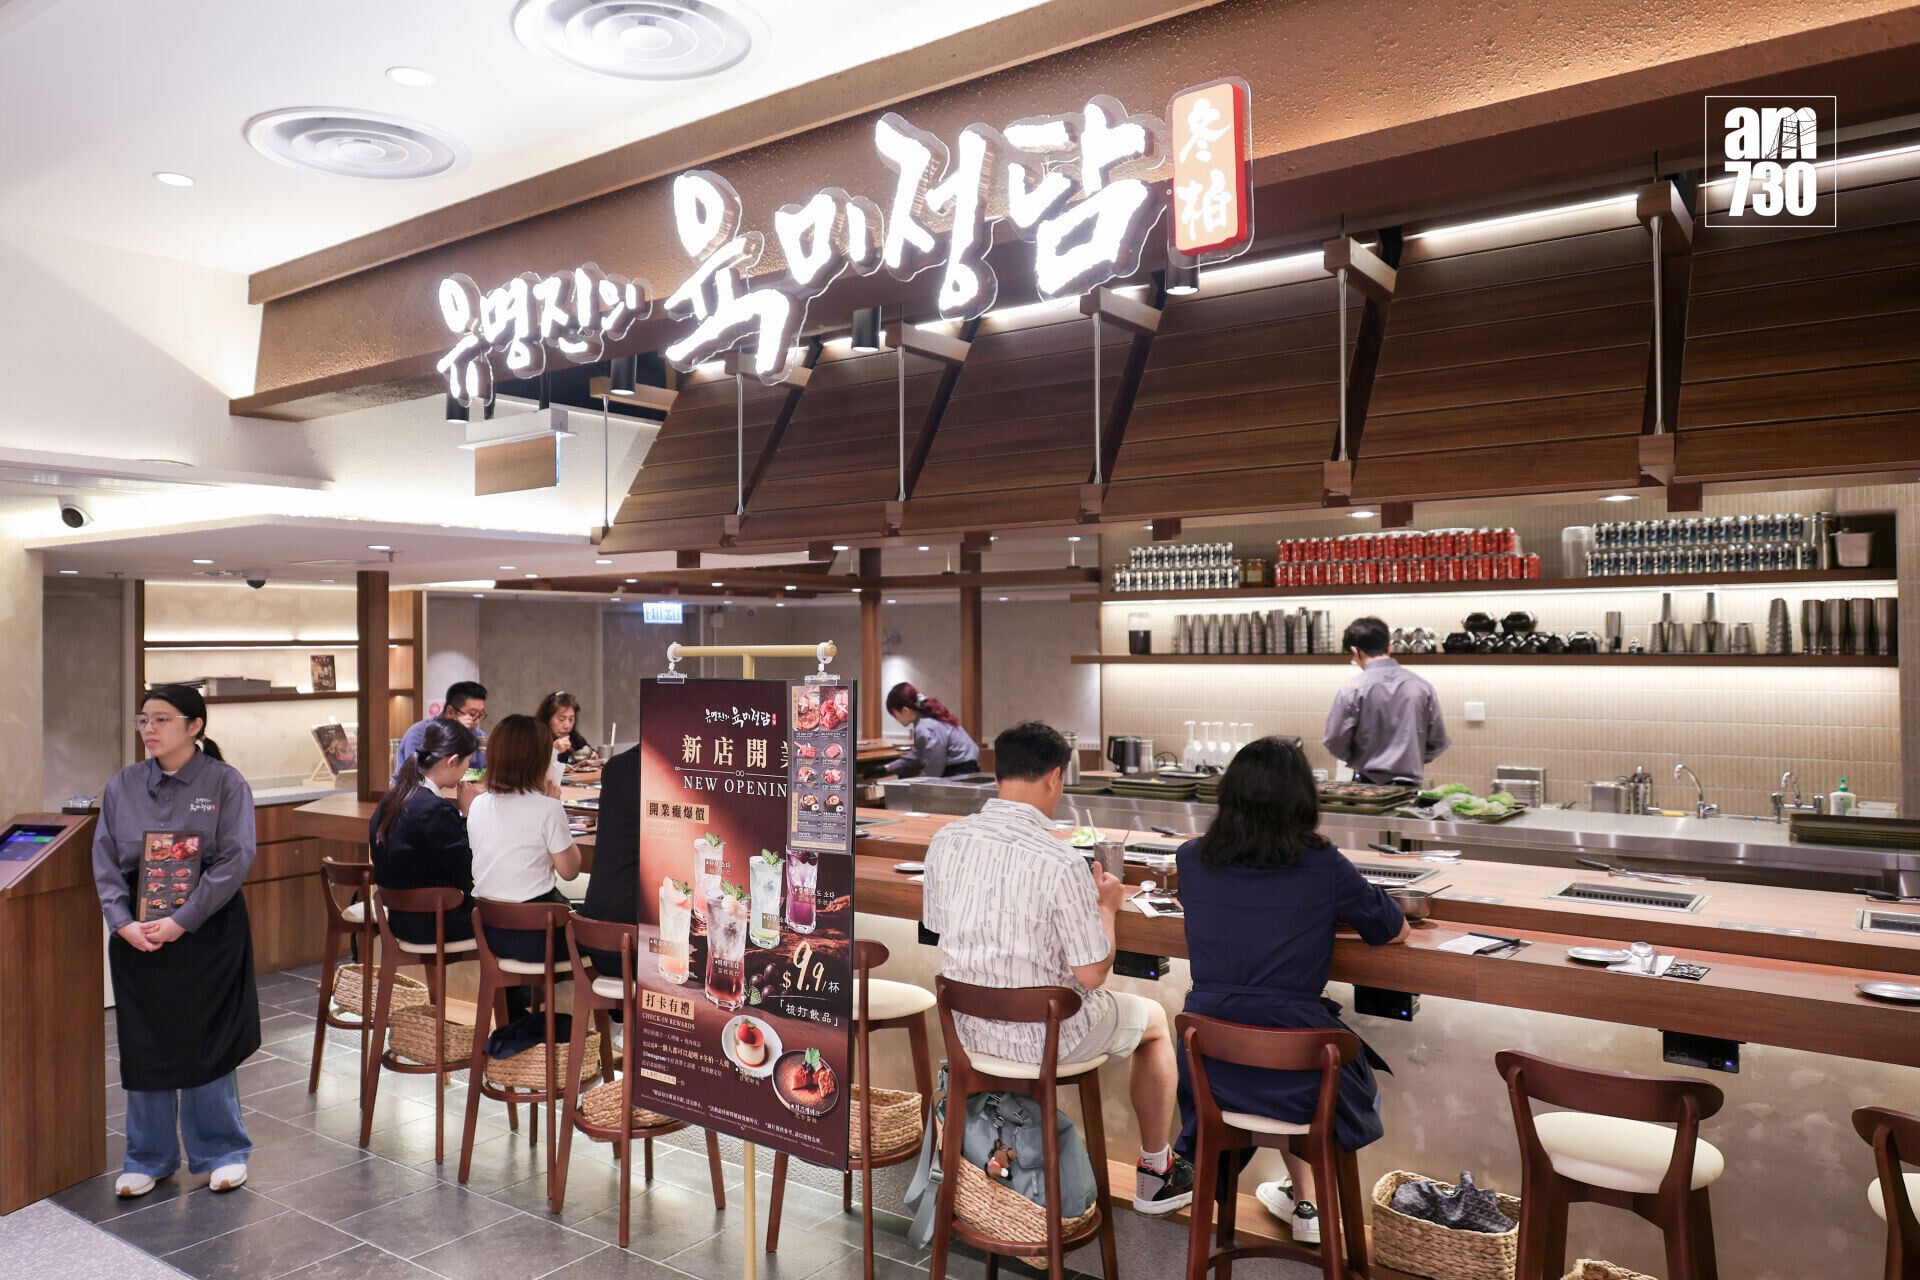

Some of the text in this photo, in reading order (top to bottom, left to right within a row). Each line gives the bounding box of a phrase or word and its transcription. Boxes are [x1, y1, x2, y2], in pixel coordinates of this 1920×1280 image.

[1176, 98, 1232, 241] 冬柏
[666, 103, 1149, 377] 육미정담
[683, 775, 718, 792] NEW
[724, 778, 788, 798] OPENIN
[646, 993, 690, 1016] 打卡有禮
[641, 1012, 695, 1030] CHECK-IN REWARDS
